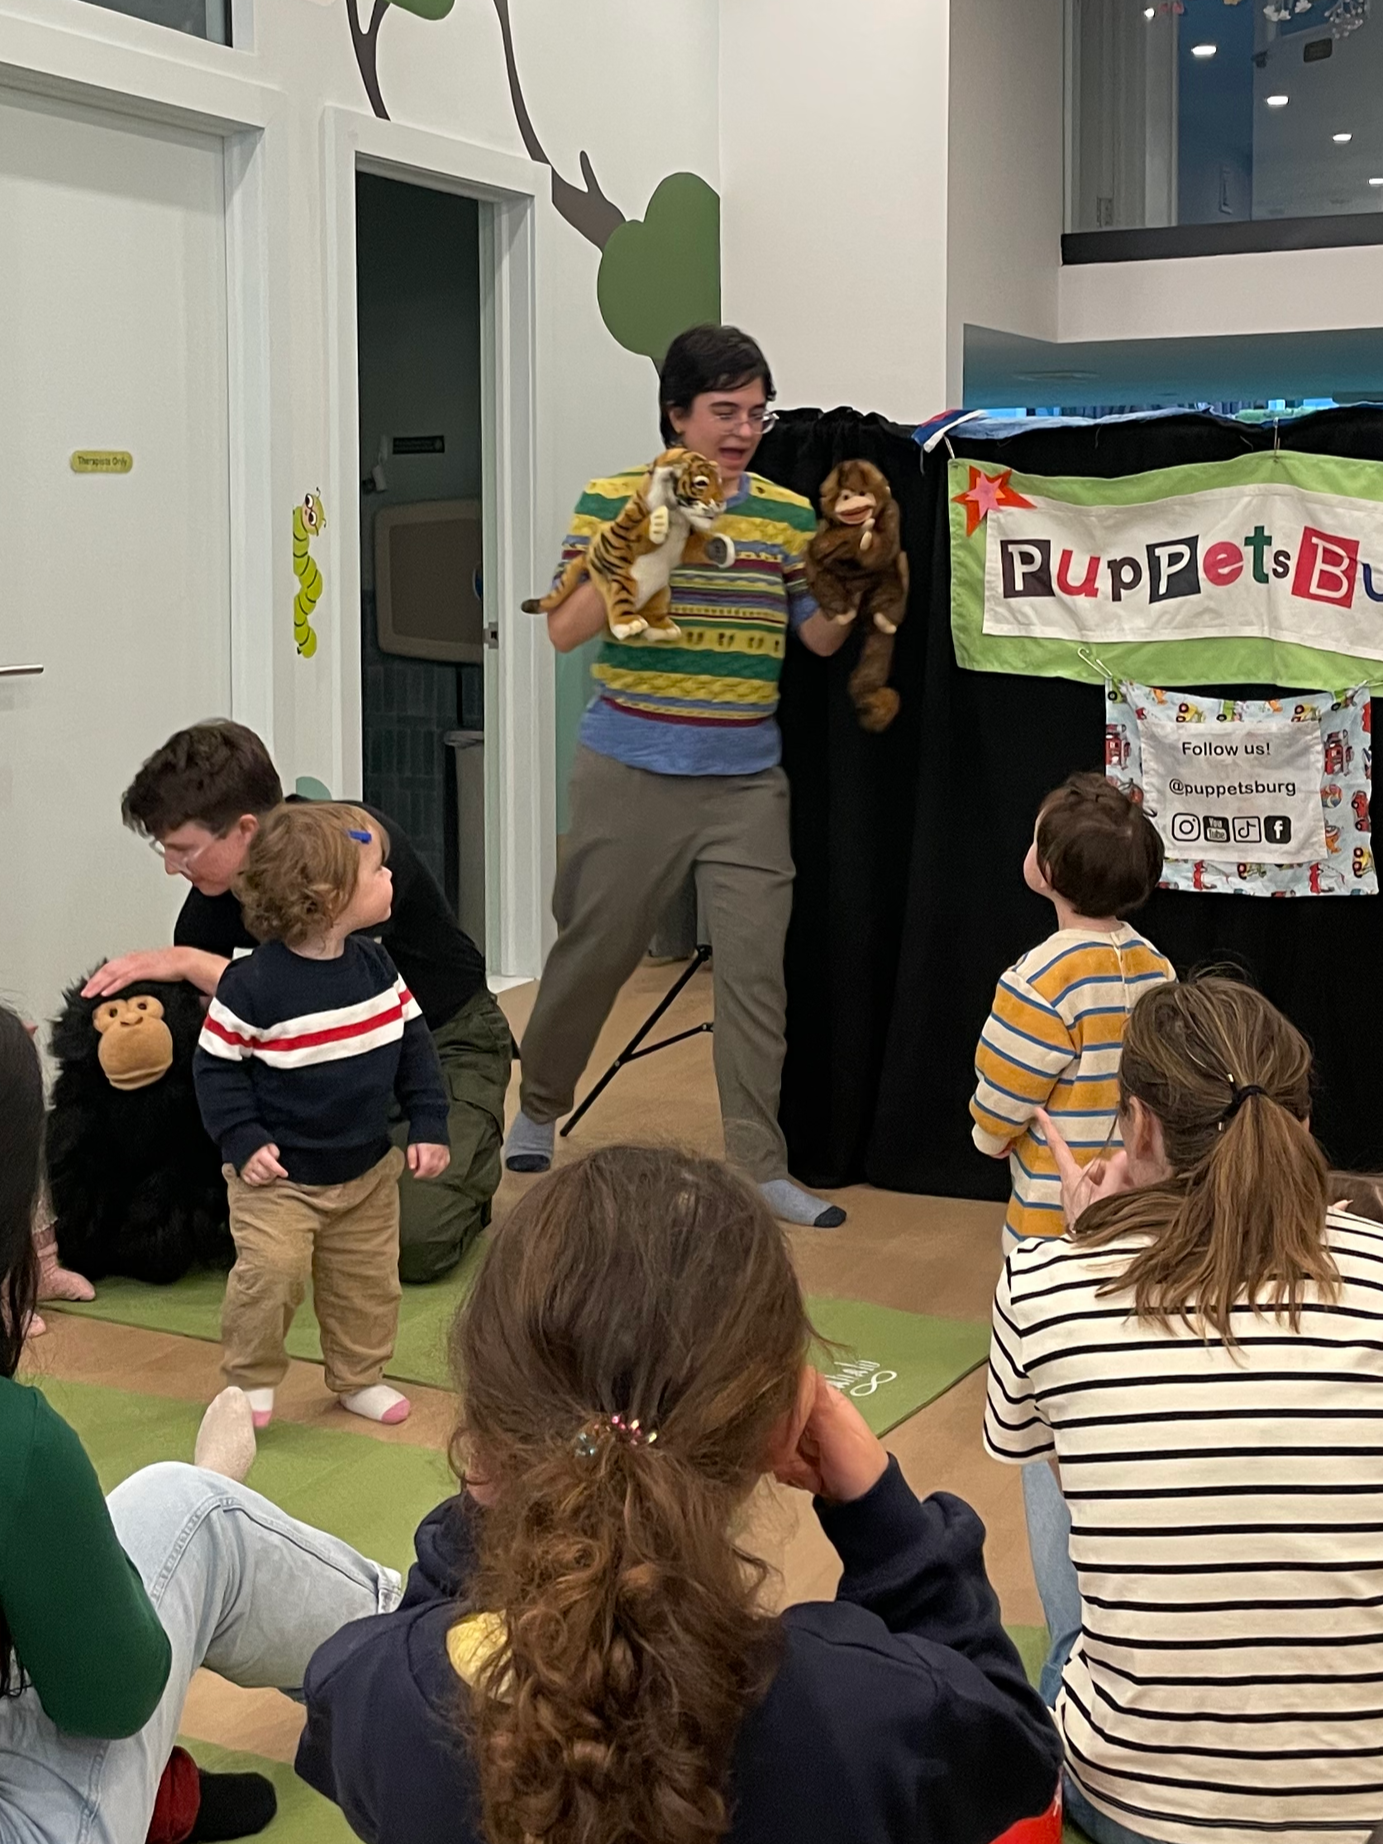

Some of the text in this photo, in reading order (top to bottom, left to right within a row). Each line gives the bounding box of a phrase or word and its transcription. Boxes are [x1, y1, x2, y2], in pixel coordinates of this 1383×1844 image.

[112, 456, 127, 467] Only
[1182, 741, 1271, 756] Follow us!
[1169, 778, 1296, 798] @puppetsburg
